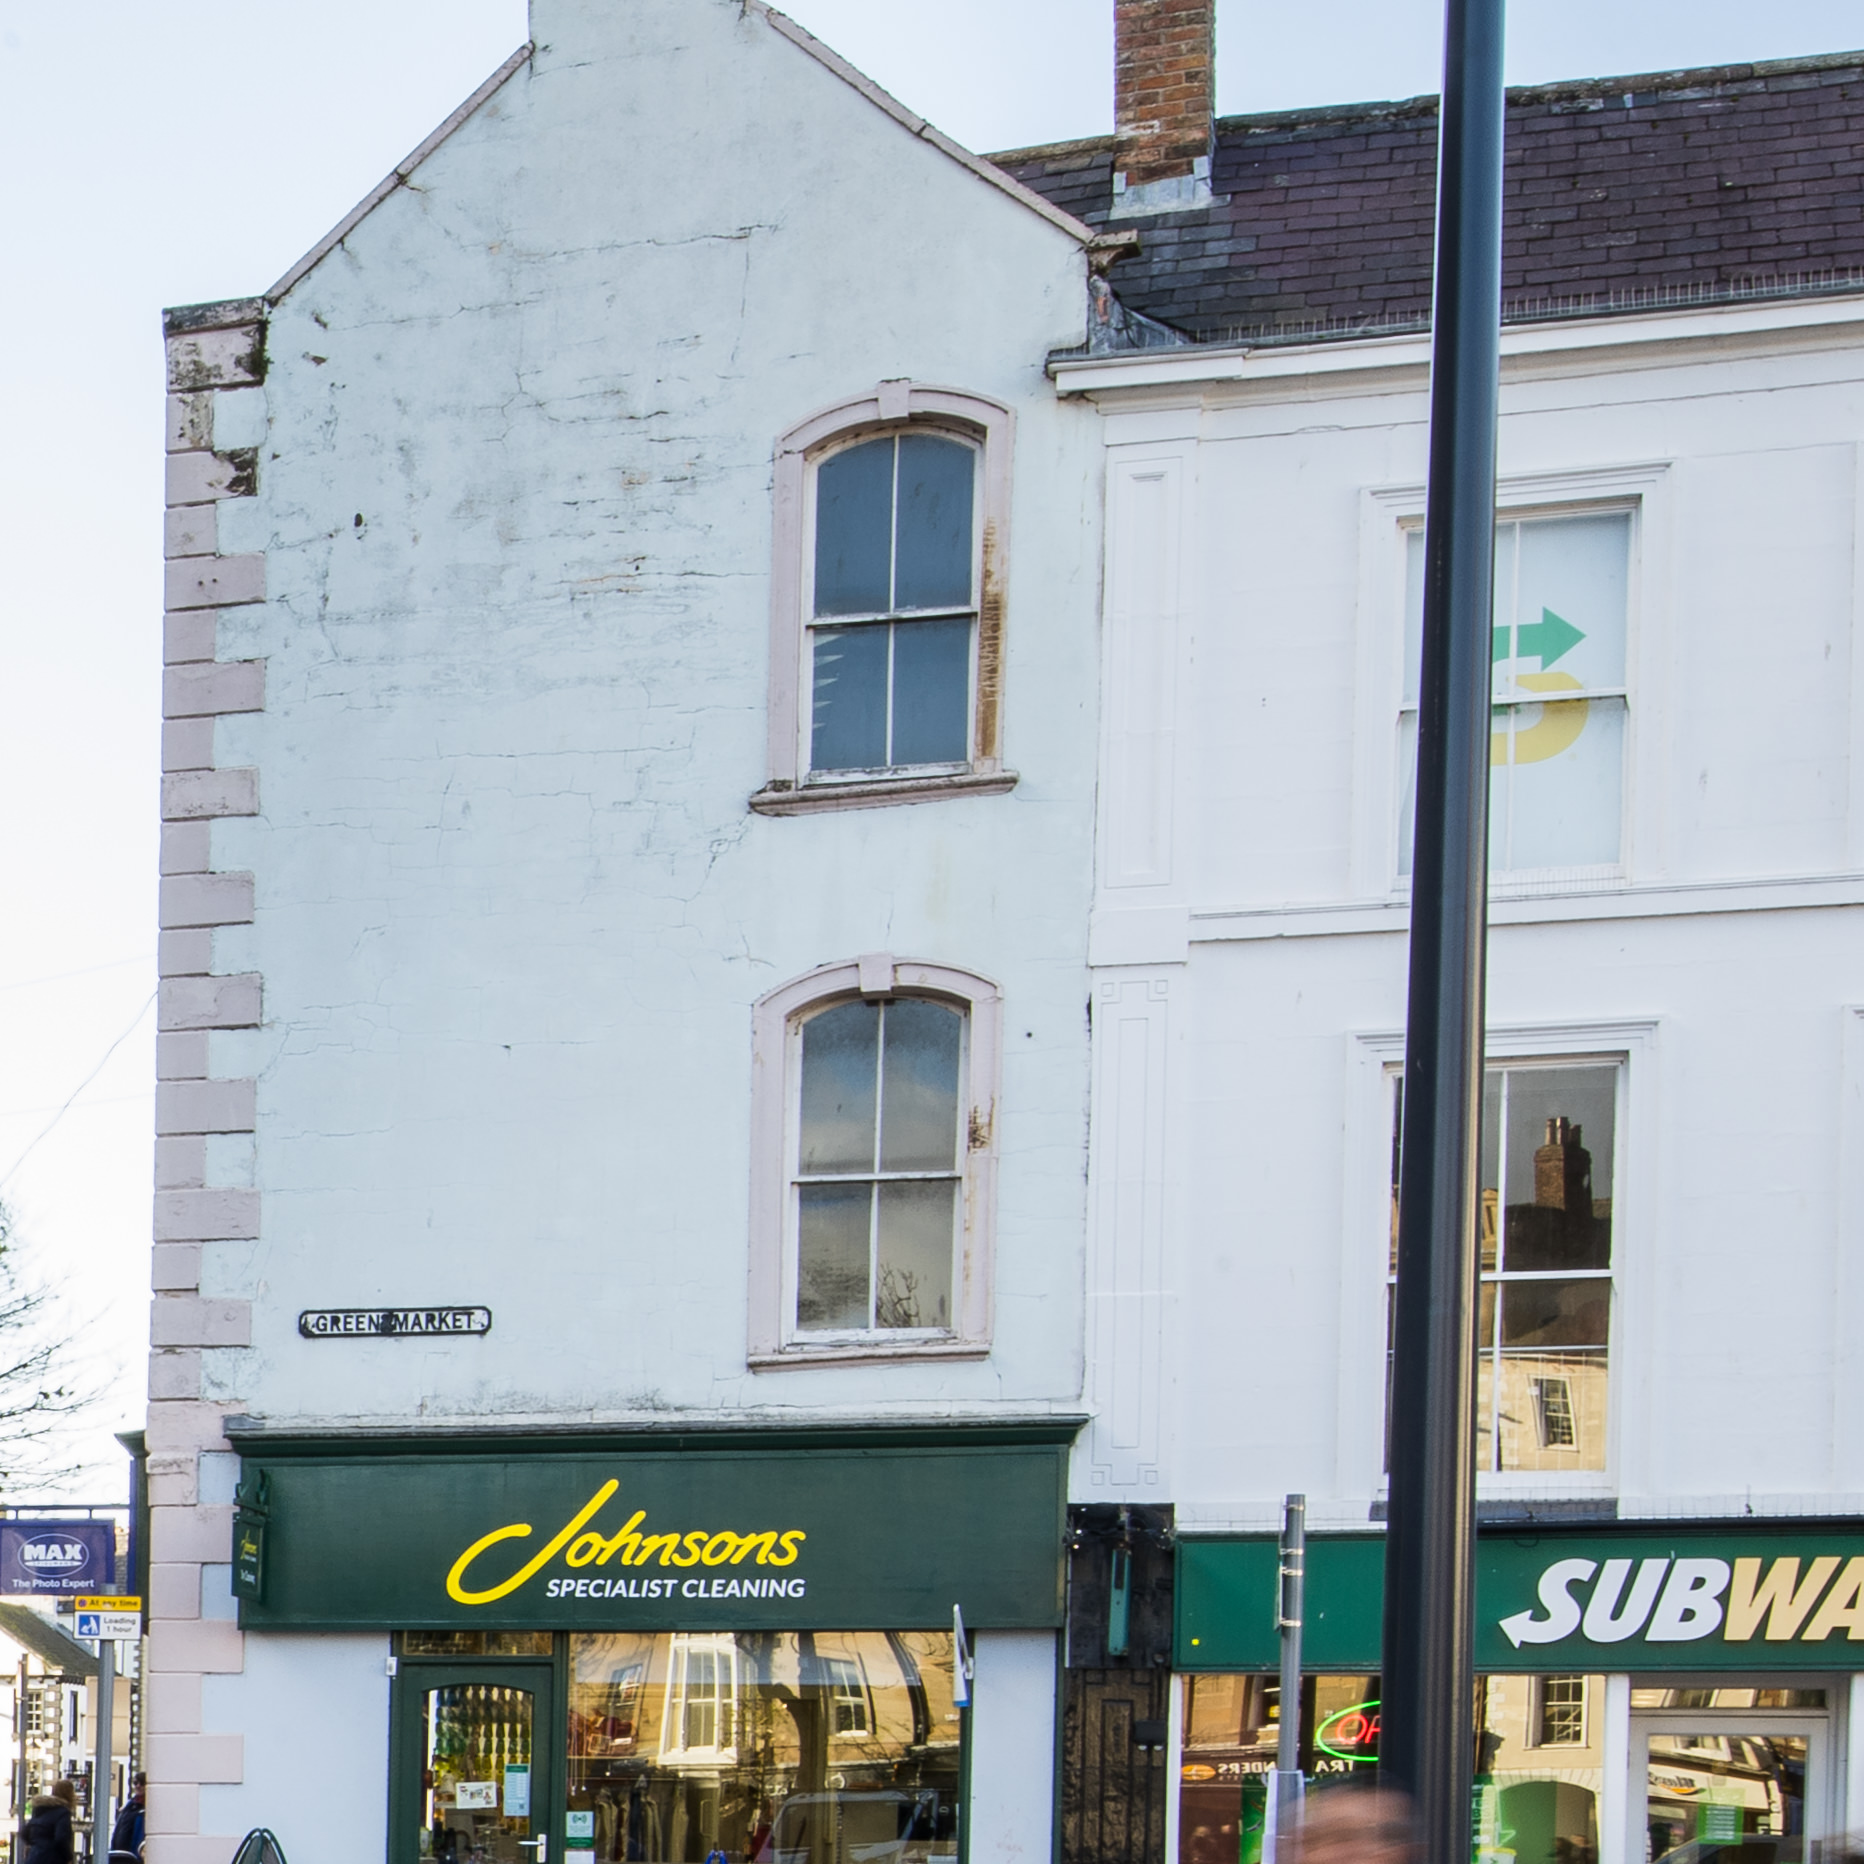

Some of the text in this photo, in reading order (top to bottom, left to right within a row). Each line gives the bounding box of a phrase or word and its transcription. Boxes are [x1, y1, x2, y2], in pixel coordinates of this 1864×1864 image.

[315, 1311, 475, 1333] GREEN MARKET
[446, 1478, 807, 1605] Johnsons
[23, 1544, 83, 1561] MAX
[12, 1579, 95, 1589] The Photo Expert
[545, 1578, 807, 1598] SPECIALIST CLEANING
[119, 1599, 139, 1607] time
[103, 1617, 137, 1626] Loading
[112, 1625, 133, 1633] hour
